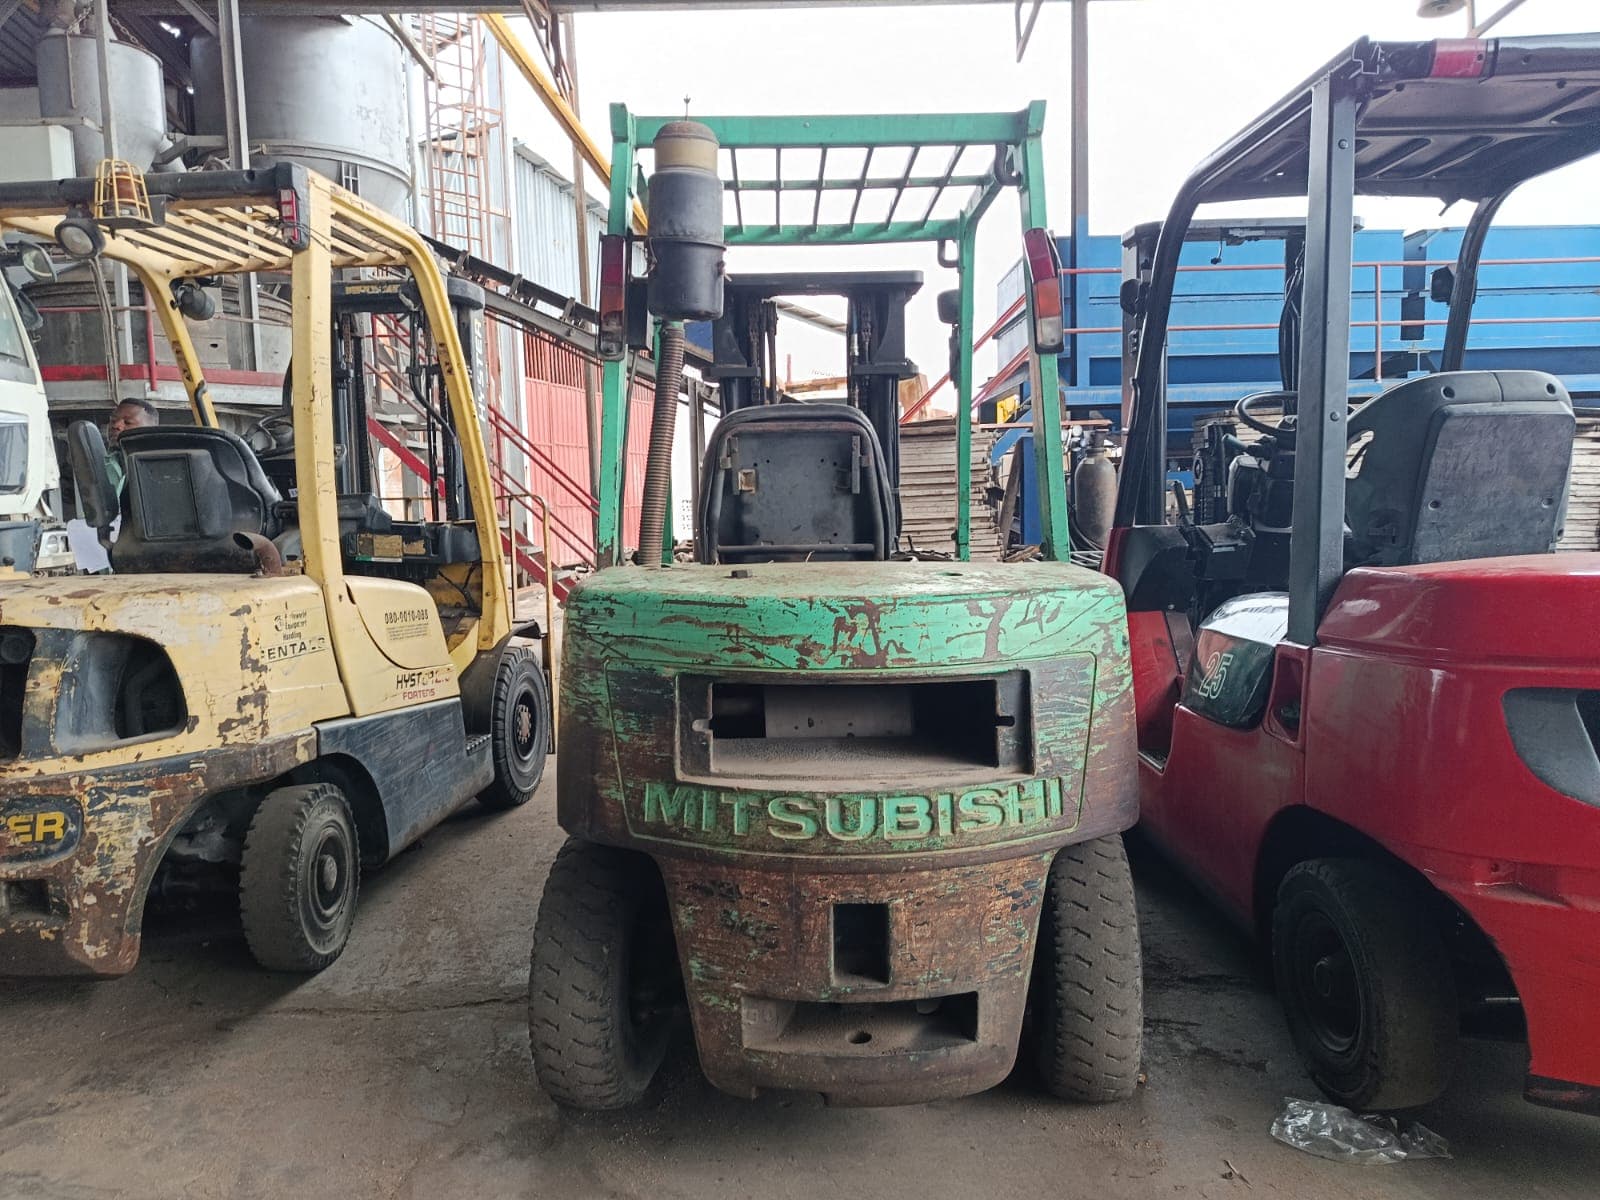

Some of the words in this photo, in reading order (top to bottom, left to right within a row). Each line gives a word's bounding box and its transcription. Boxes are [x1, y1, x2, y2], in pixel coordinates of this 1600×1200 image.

[474, 319, 486, 422] HYSTER
[1199, 651, 1234, 699] 25
[0, 811, 65, 843] ER
[643, 777, 1063, 842] MITSUBISHI
